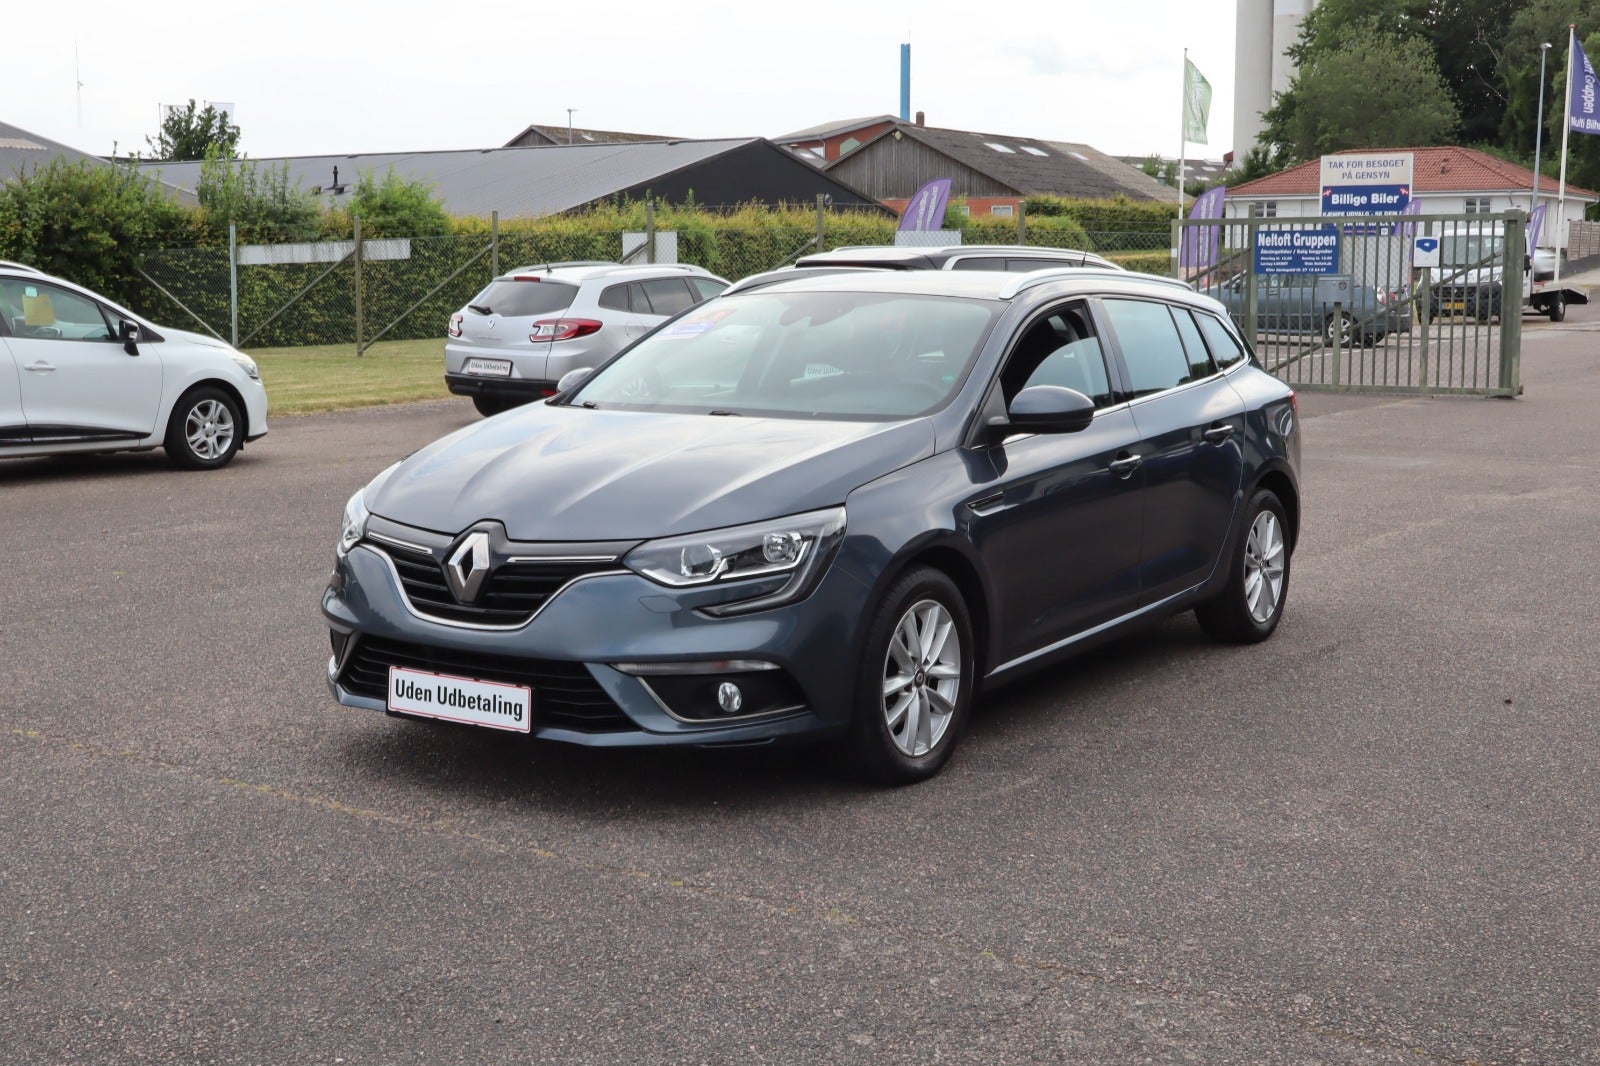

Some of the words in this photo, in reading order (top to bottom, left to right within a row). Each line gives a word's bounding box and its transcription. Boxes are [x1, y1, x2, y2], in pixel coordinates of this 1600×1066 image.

[1581, 75, 1596, 114] Gruppen
[1328, 161, 1344, 169] TAK
[1346, 160, 1363, 169] FOR
[1342, 171, 1352, 180] PÅ
[1355, 171, 1390, 180] GENSYN
[1331, 193, 1367, 207] Billige
[1371, 192, 1399, 204] Biler
[1258, 232, 1291, 247] Neltoft
[1293, 232, 1336, 248] Gruppen
[395, 678, 432, 702] Uden
[437, 684, 523, 722] Udbetaling
